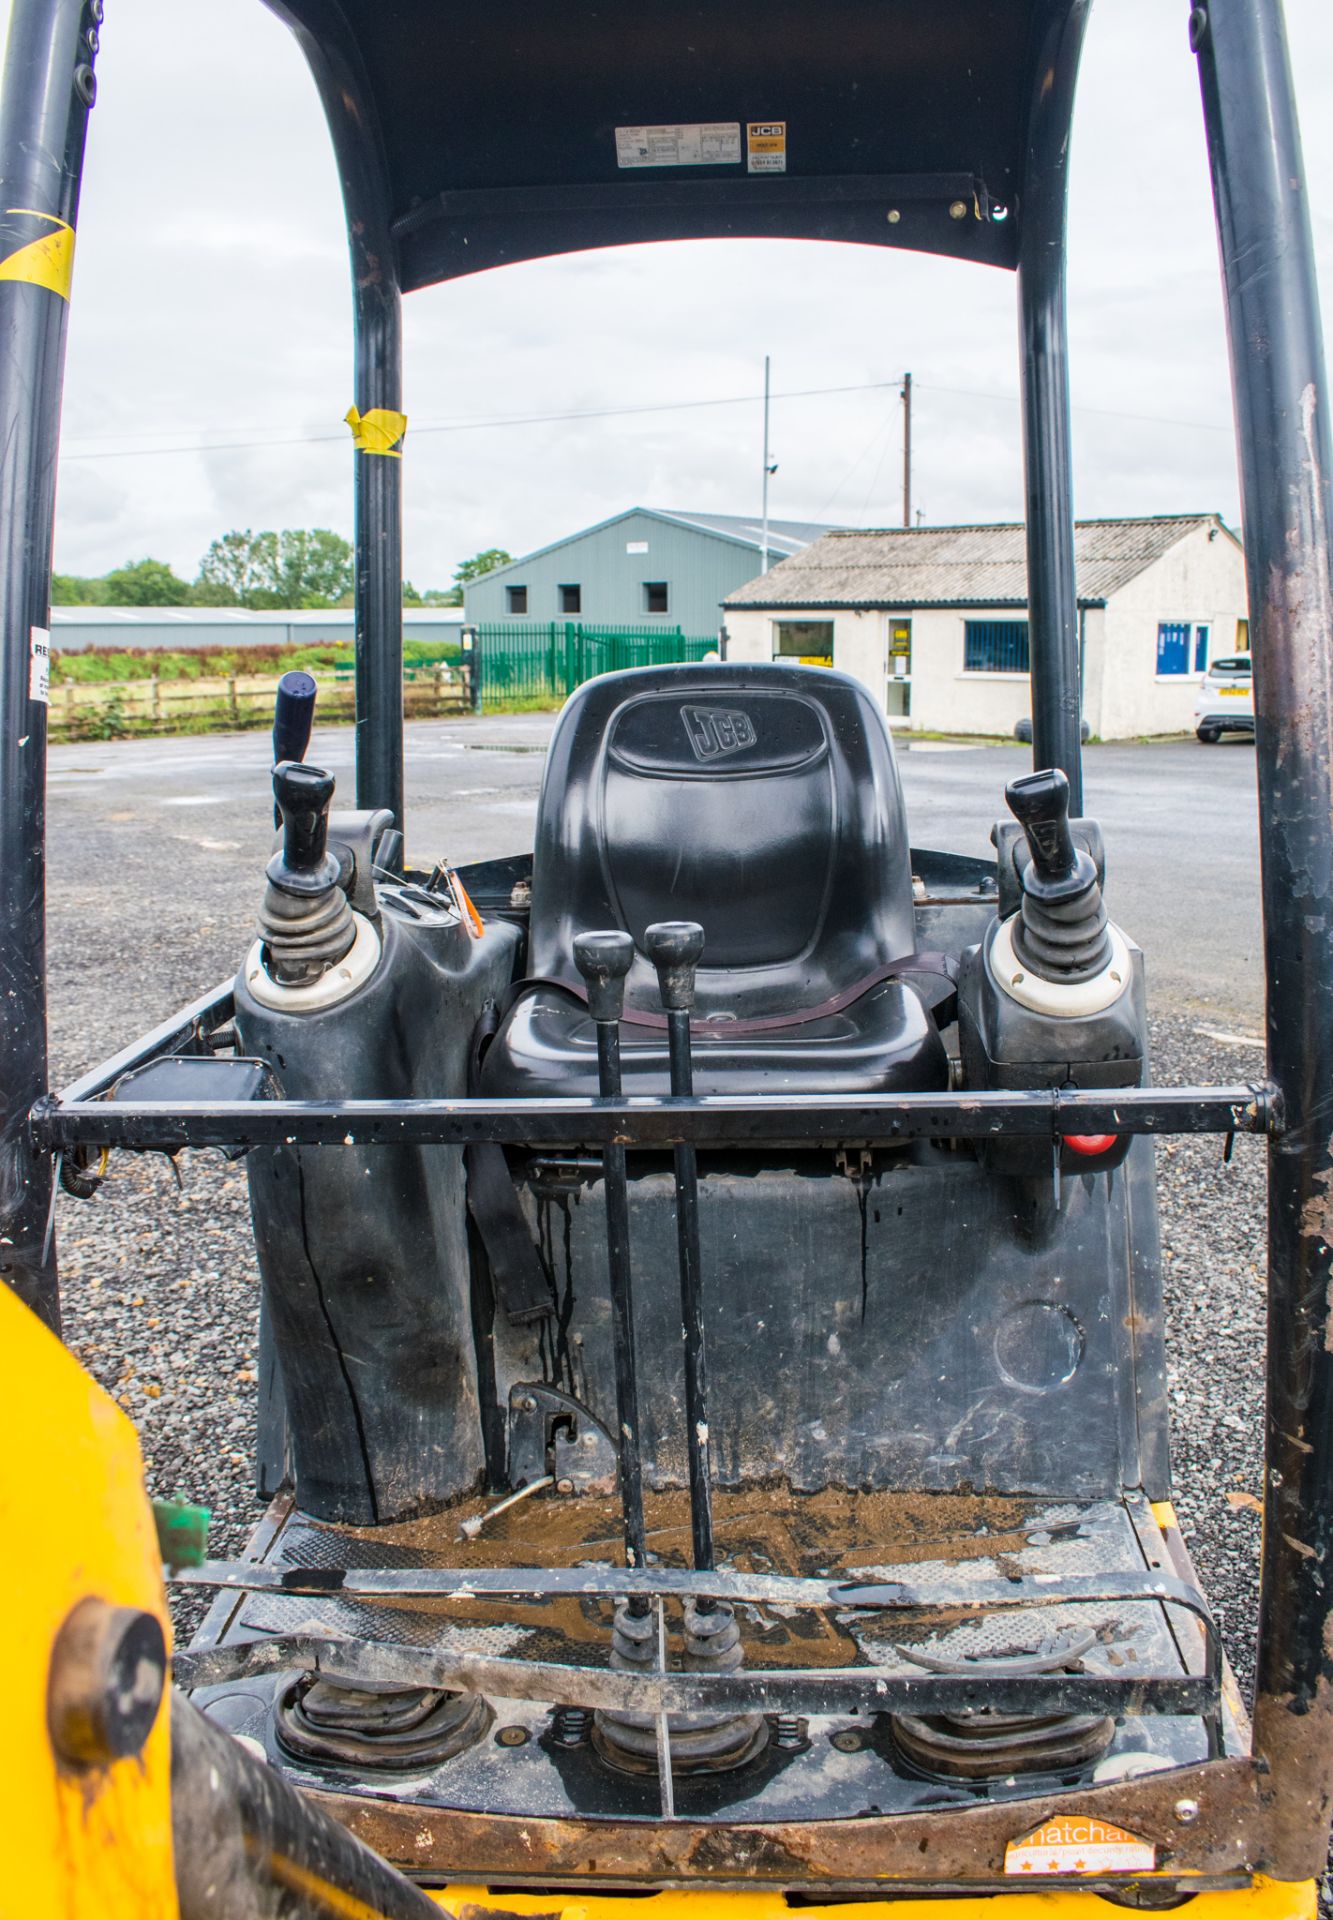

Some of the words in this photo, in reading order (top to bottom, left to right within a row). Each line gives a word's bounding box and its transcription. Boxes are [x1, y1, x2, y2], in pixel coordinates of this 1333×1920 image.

[752, 126, 782, 136] JCB
[35, 643, 49, 657] RE
[693, 711, 752, 756] JCB
